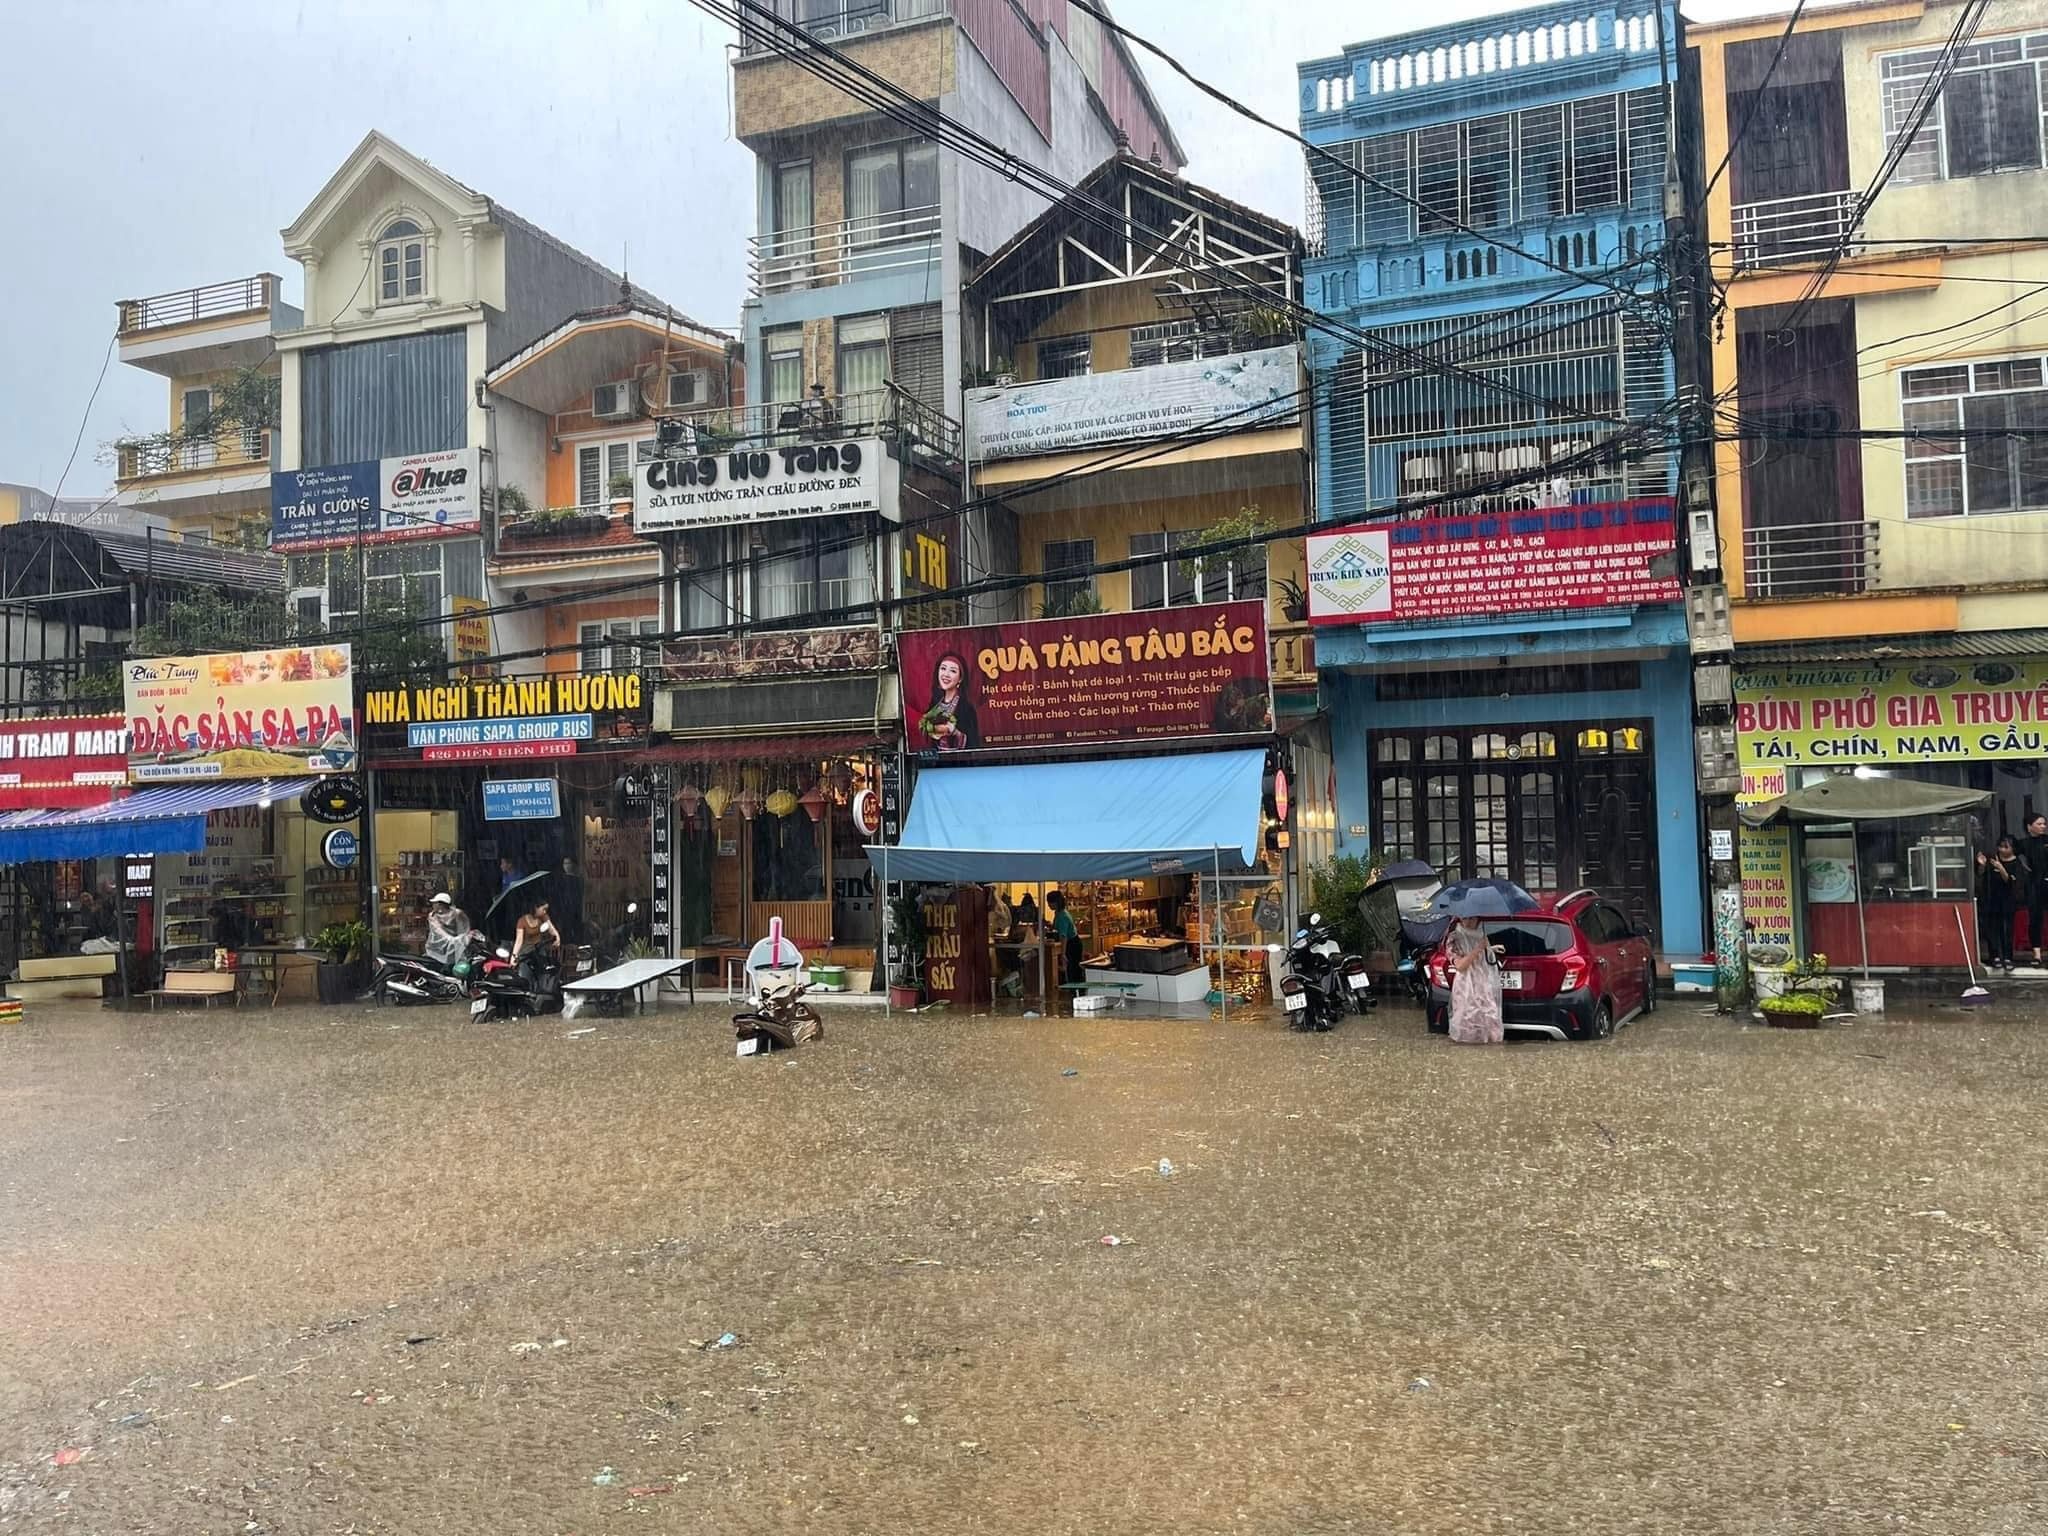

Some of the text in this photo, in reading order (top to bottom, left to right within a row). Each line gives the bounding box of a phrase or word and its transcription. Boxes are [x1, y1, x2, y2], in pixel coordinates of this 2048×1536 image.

[1007, 404, 1047, 418] HOA TƯƠI
[1011, 428, 1034, 440] CUNG
[1054, 422, 1072, 433] HOA
[1074, 418, 1094, 430] TƯƠI
[1096, 416, 1107, 426] VÀ
[1109, 413, 1125, 425] CÁC
[1126, 411, 1147, 422] DỊCH
[1174, 404, 1192, 415] HOA
[646, 442, 863, 490] Cing Hu Tang
[322, 494, 370, 514] CƯỜNG
[650, 476, 862, 509] SỮA TƯƠI NƯỚNG TRÂN CHÂU ĐƯỜNG ĐEN
[71, 512, 119, 526] HOMESTAY
[916, 532, 948, 591] TRÍ
[1309, 566, 1390, 583] TRUNG SAPA
[978, 637, 1038, 680] QUÀ
[1041, 634, 1123, 675] TẶNG
[1192, 614, 1255, 656] BẮC
[982, 684, 999, 696] Hạt
[1043, 679, 1069, 691] Bánh
[1071, 677, 1089, 690] hạt
[1105, 674, 1125, 687] loại
[1127, 673, 1133, 684] 1
[1142, 671, 1163, 684] Thịt
[1165, 669, 1187, 681] trâu
[1211, 665, 1232, 679] bếp
[366, 673, 641, 723] NHÀ NGHỈ THÀNH HƯƠNG
[989, 696, 1018, 710] Rượu
[1094, 689, 1129, 704] hương
[1166, 683, 1200, 697] Thuốc
[1203, 681, 1222, 694] bắc
[1079, 705, 1099, 717] Các
[1101, 703, 1120, 717] loại
[1122, 703, 1139, 716] hạt
[1148, 700, 1174, 713] Thảo
[1177, 699, 1200, 713] mộc
[1738, 687, 1942, 732] BÚN PHỞ GIA
[75, 729, 128, 756] MART
[132, 696, 343, 765] ĐẶC SẢN SA PA
[412, 719, 588, 745] VĂN PHÒNG SAPA GROUP BUS
[428, 750, 452, 760] 426
[1753, 737, 1800, 761] TÁI,
[1810, 734, 1887, 758] CHÍN,
[1897, 735, 1969, 759] NẠM,
[486, 781, 551, 794] SAPA GROUP BUS
[1762, 768, 1785, 794] PHỞ
[127, 864, 151, 880] MART
[1765, 874, 1785, 891] CHẢ
[923, 903, 957, 934] THỊT
[925, 930, 961, 959] TRÂU
[1759, 932, 1791, 945] 30-50K
[931, 957, 956, 991] SẤY
